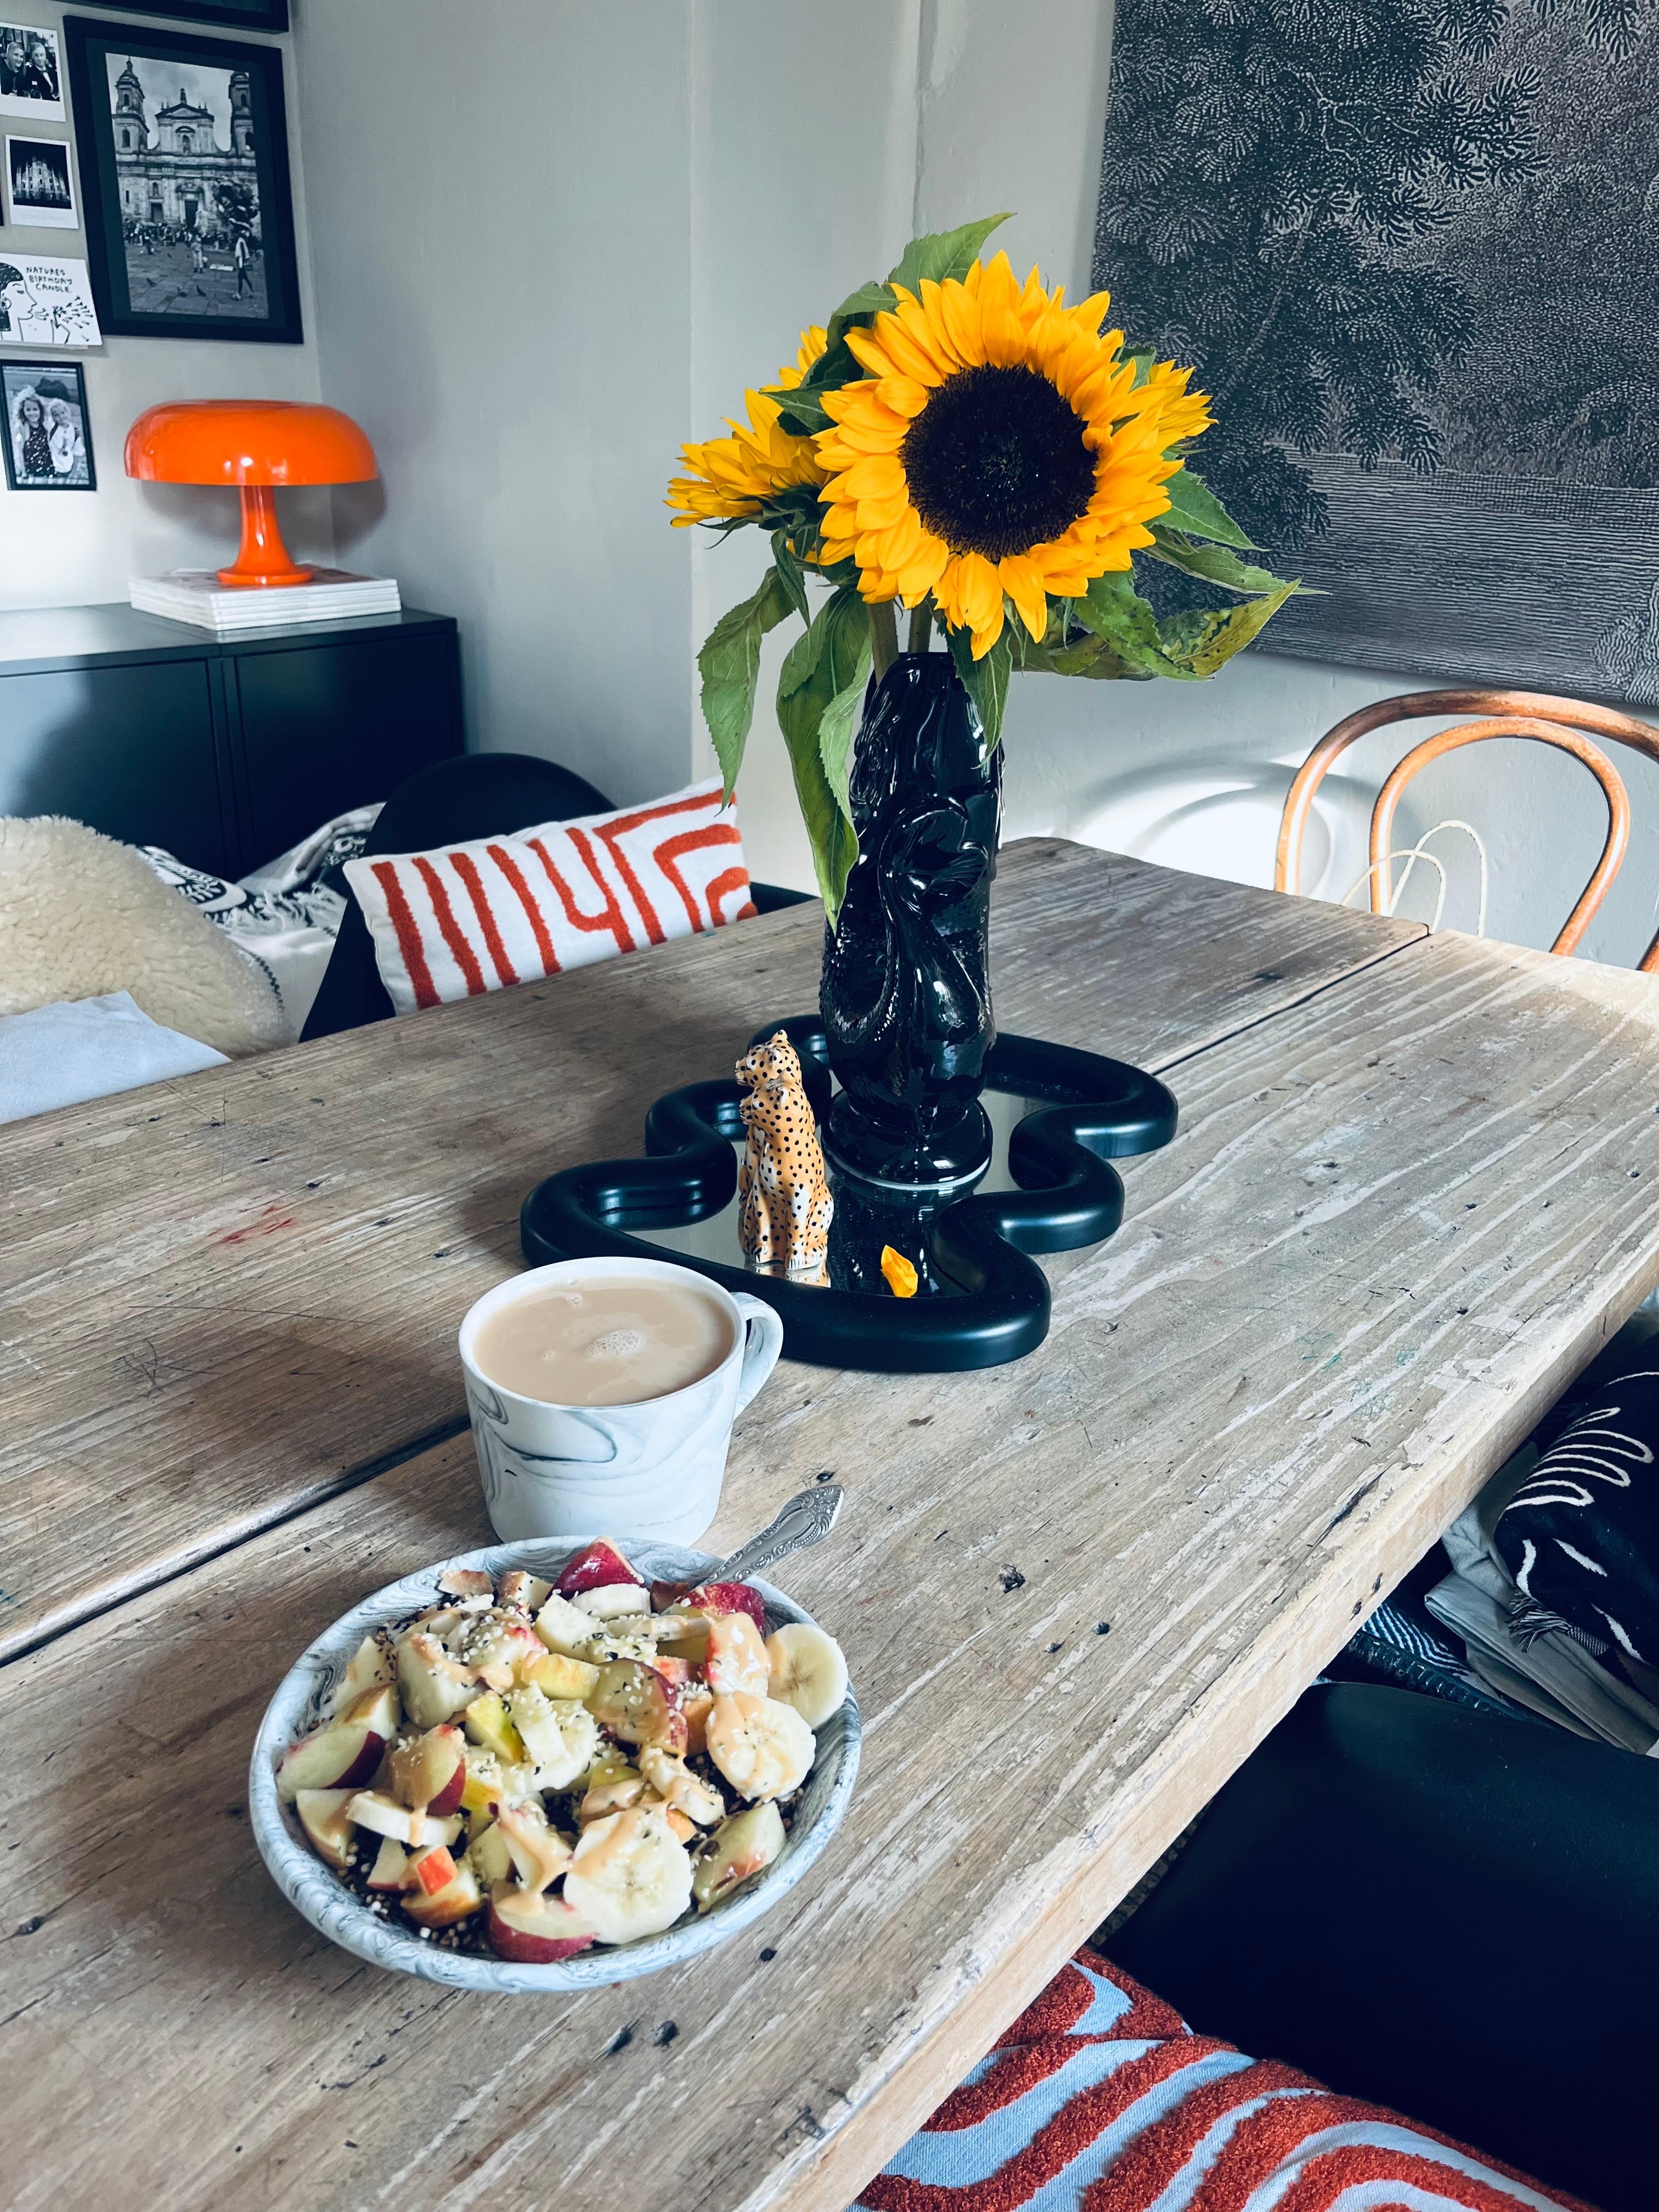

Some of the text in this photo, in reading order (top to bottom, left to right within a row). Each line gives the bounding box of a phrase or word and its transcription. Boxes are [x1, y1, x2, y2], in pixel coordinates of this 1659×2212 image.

[26, 267, 65, 275] NATURES
[29, 275, 72, 285] BIRTHDAY
[36, 283, 70, 293] CANDLE
